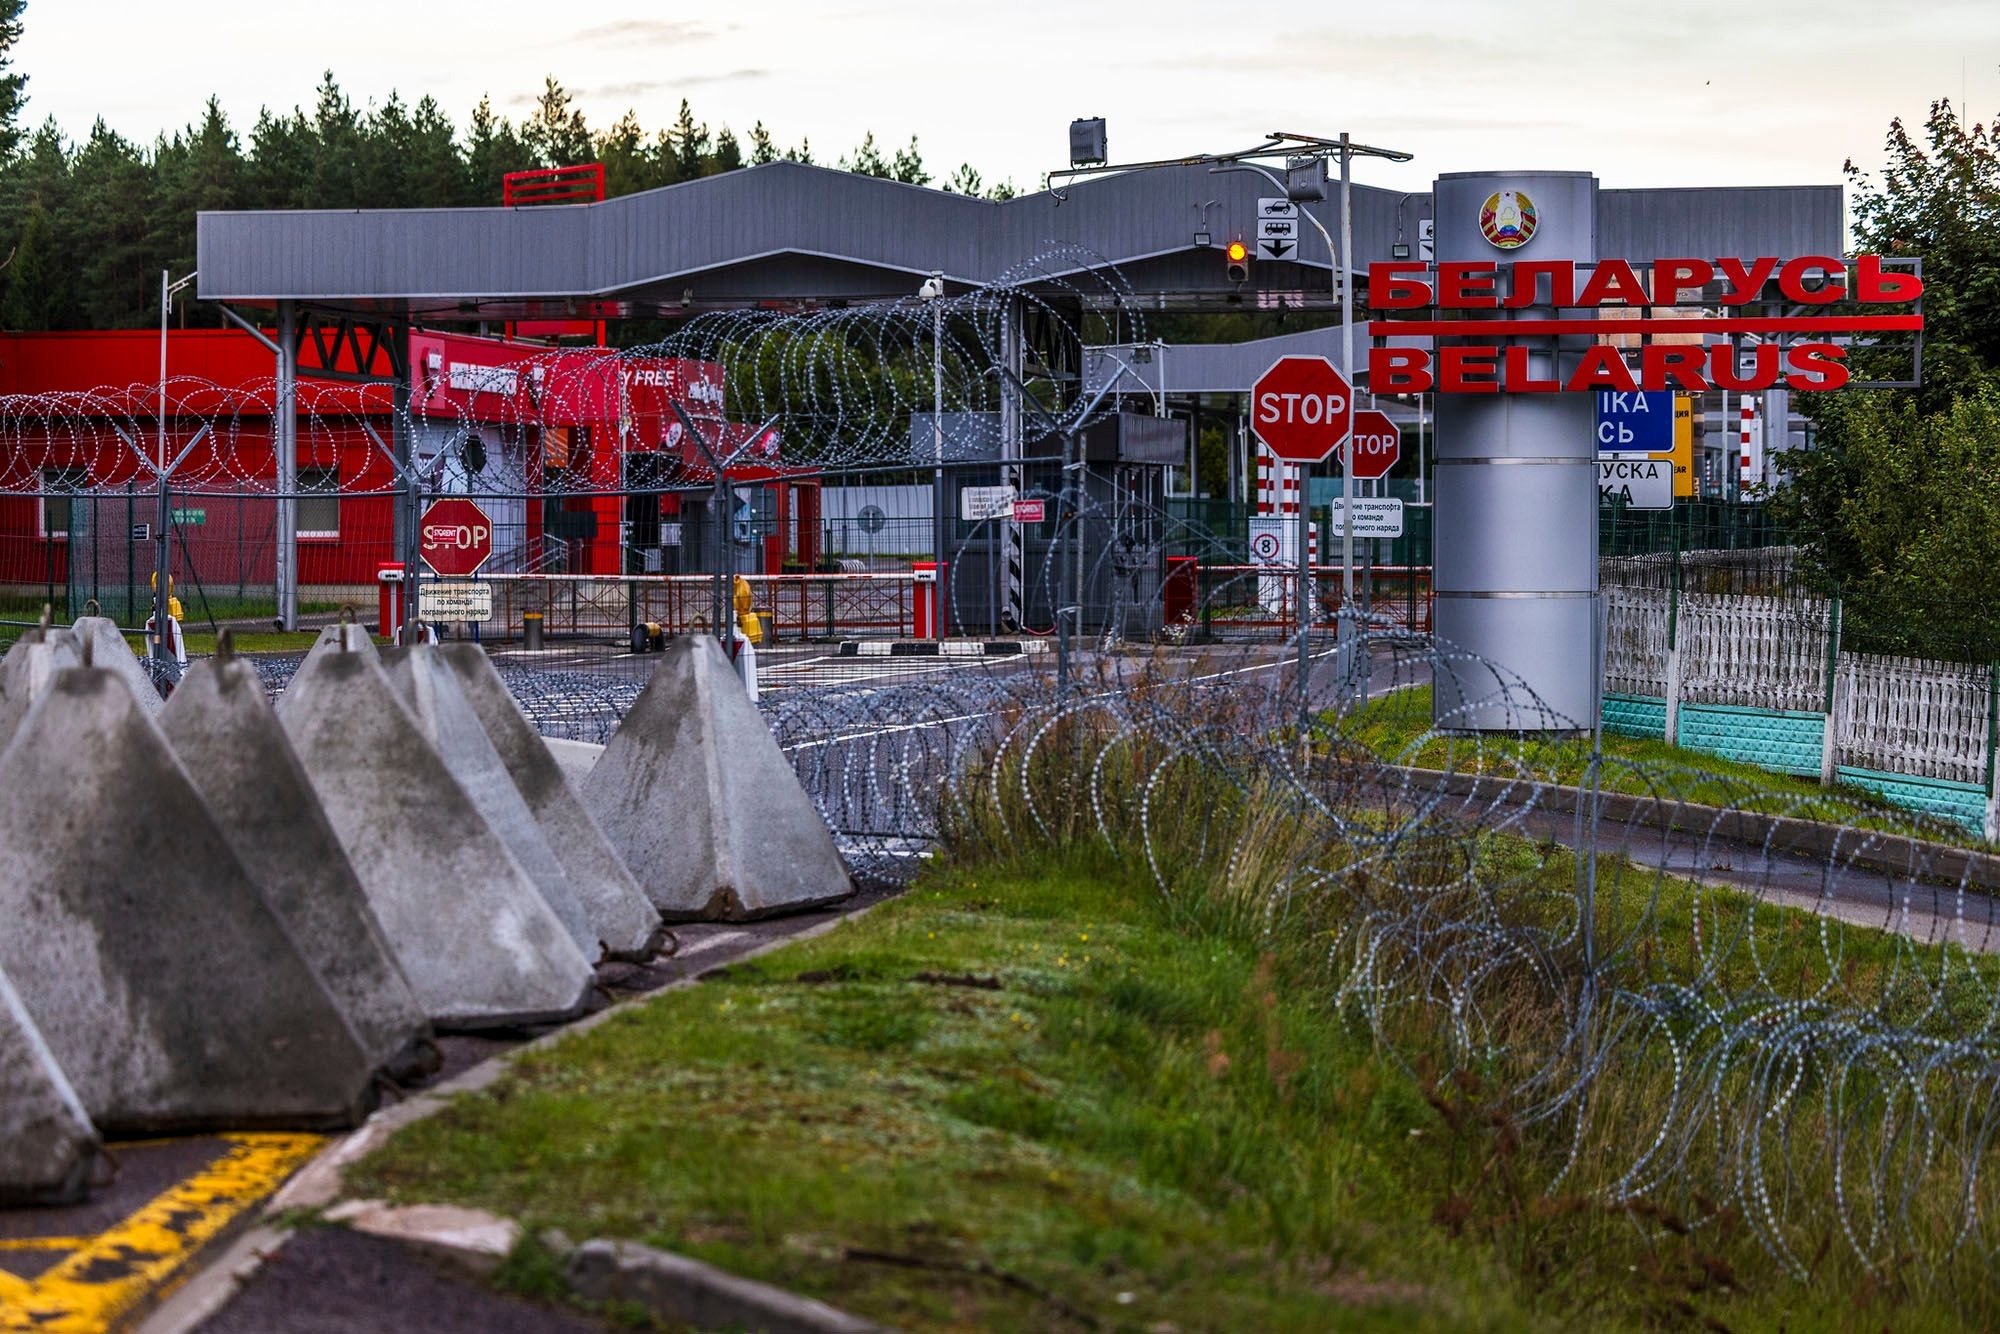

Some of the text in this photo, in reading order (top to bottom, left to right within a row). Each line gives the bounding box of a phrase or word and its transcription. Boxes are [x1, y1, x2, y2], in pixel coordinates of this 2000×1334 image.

[1369, 255, 1924, 309] БЕЛАРУСЬ
[1369, 343, 1849, 393] BELARUS
[634, 370, 675, 387] FREE
[1259, 392, 1346, 425] STOP
[1603, 390, 1650, 413] ІКА
[1598, 421, 1634, 443] СЬ
[1344, 434, 1395, 455] TOP
[1599, 462, 1659, 479] УСКА
[1598, 484, 1635, 506] КА
[1364, 503, 1401, 512] транспорта
[1358, 514, 1384, 522] команде
[423, 525, 488, 550] SOP
[1376, 524, 1400, 533] наряда
[1262, 540, 1271, 554] 8
[420, 588, 490, 597] Движение транспорта
[421, 609, 489, 617] пограничного наряда
